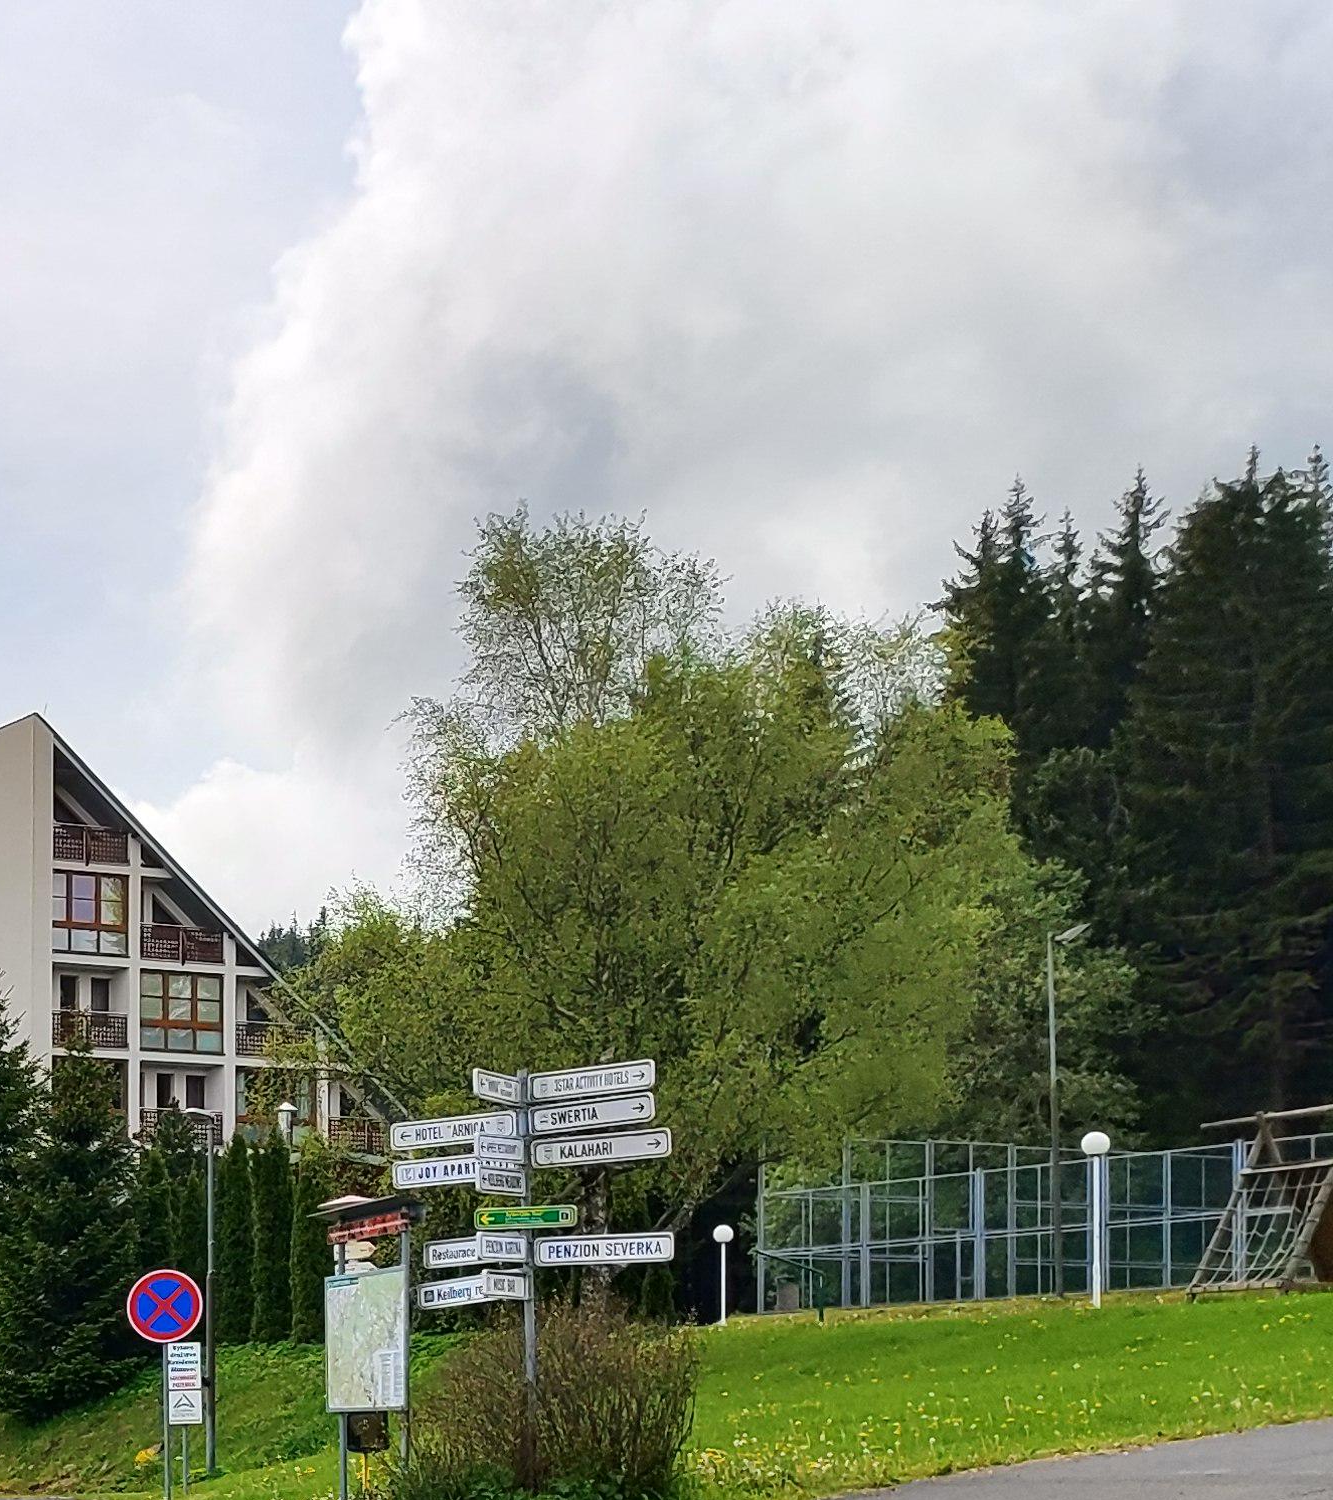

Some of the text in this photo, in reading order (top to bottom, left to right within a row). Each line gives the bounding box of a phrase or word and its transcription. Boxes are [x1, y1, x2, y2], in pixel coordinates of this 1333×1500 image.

[550, 1107, 599, 1125] SWERTIA
[415, 1126, 444, 1141] HOTEL
[559, 1141, 613, 1159] KALAHARI
[418, 1165, 438, 1179] JOY
[432, 1247, 476, 1261] Restaurace
[547, 1241, 663, 1259] PENZION SEVERKA
